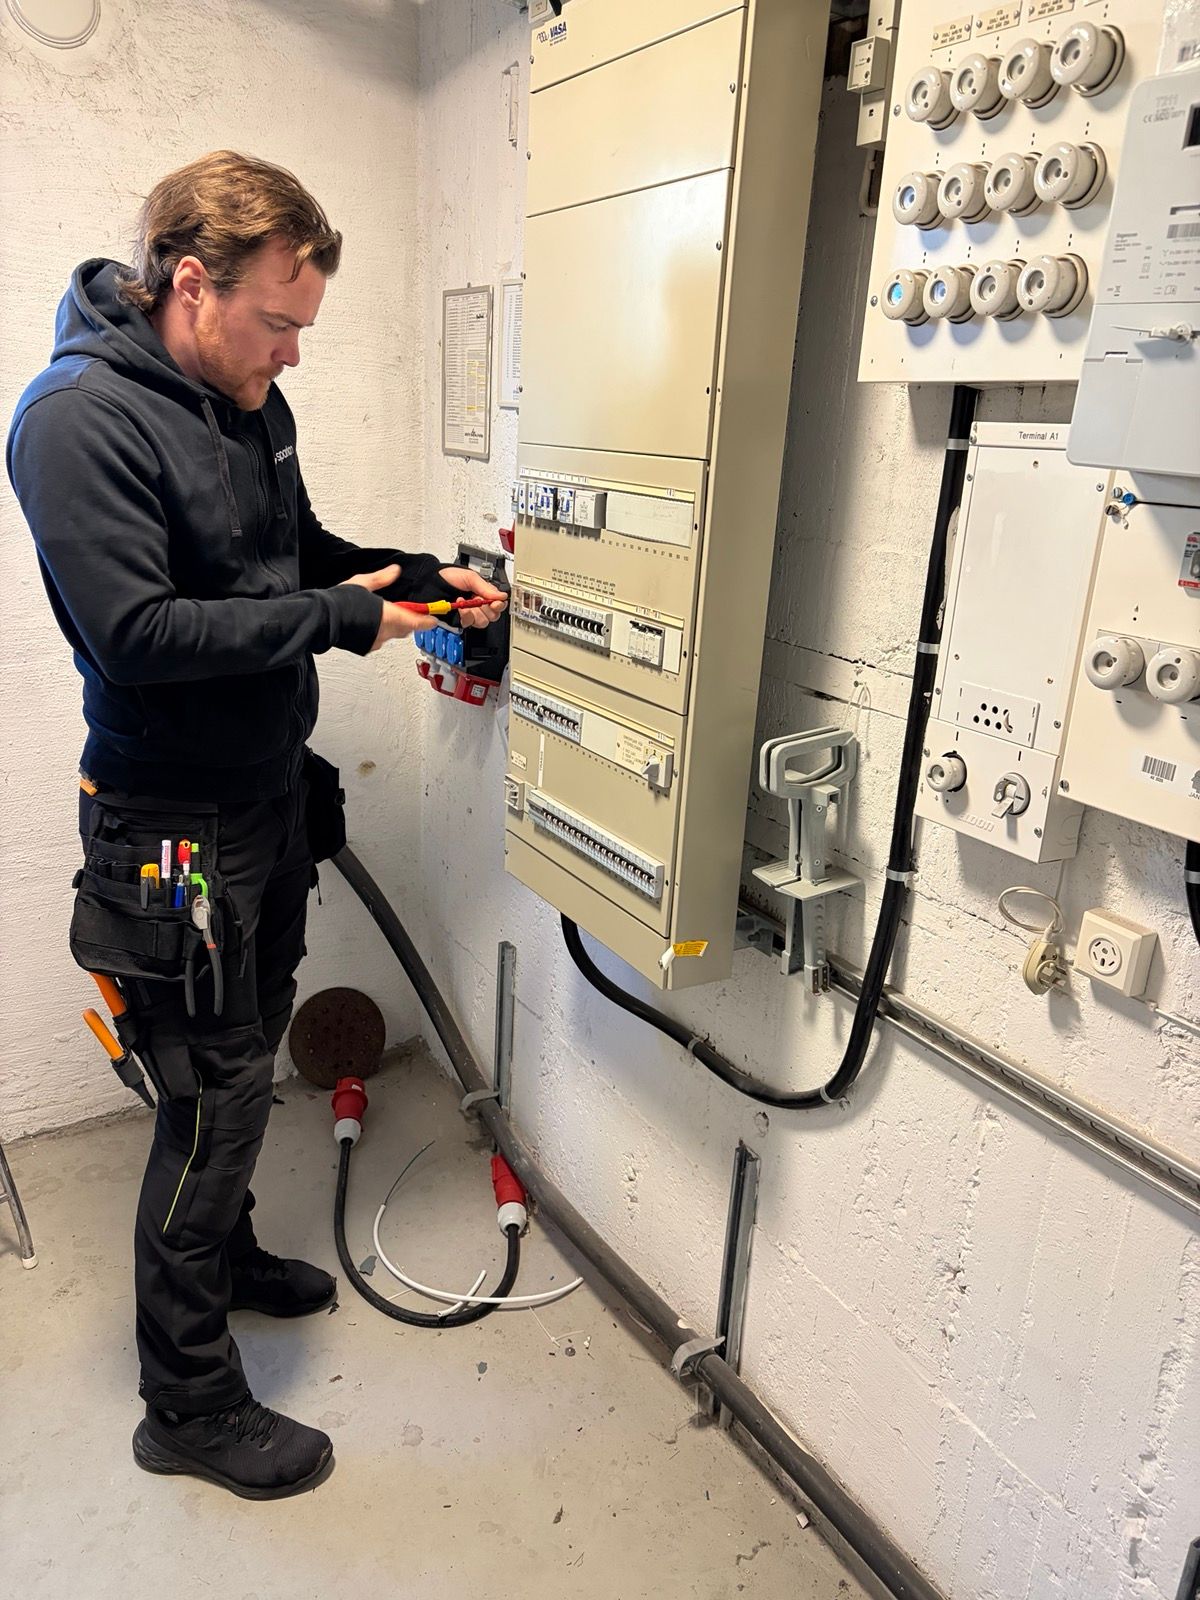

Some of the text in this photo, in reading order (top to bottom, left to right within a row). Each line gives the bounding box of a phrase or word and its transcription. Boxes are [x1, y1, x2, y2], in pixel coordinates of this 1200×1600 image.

[549, 21, 567, 38] VASA
[1019, 431, 1059, 440] Terminal A1
